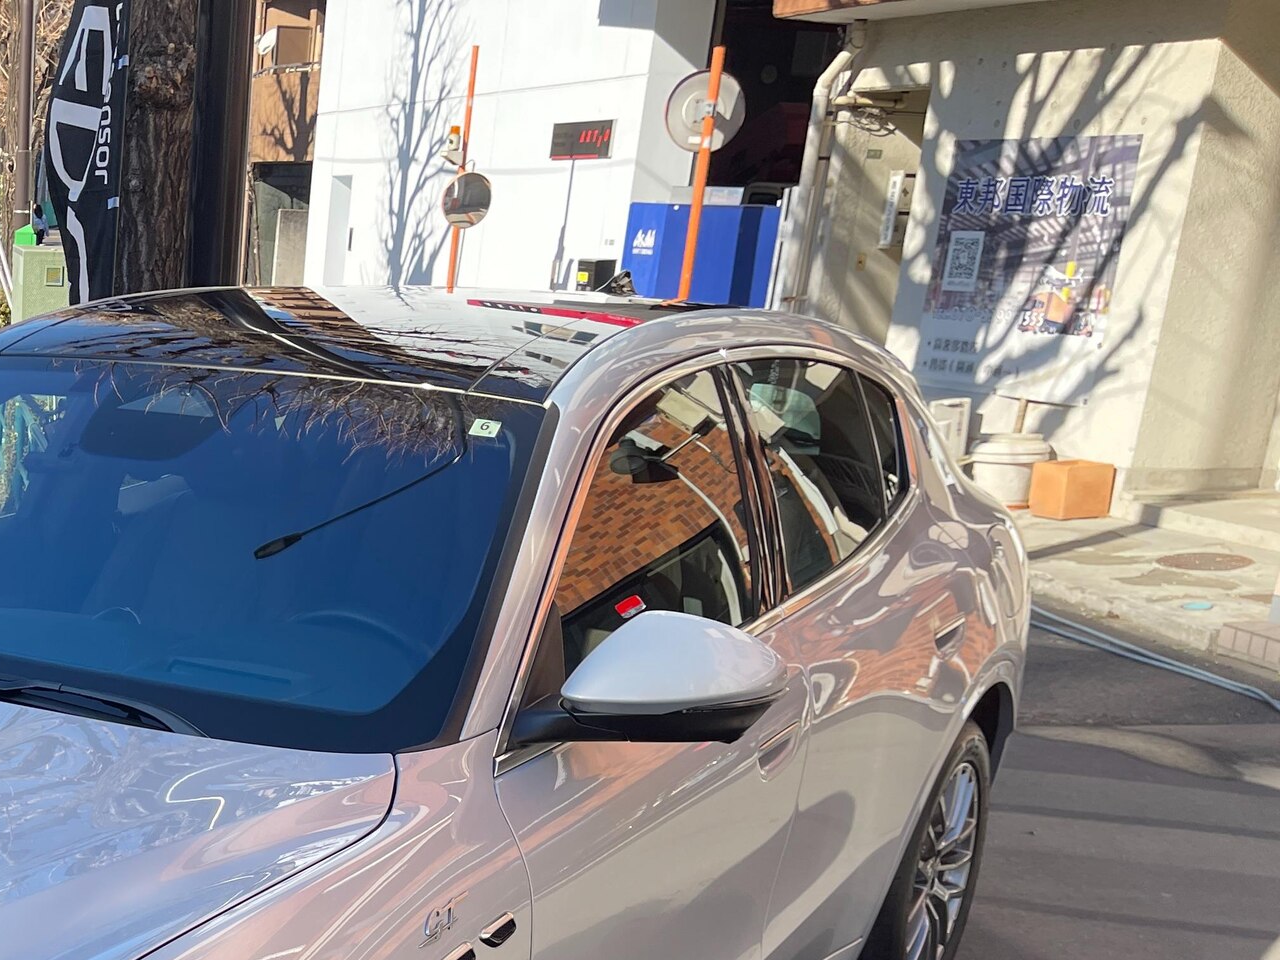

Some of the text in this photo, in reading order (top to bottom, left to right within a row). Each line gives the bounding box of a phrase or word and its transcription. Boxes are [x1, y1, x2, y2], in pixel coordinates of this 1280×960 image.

[952, 175, 1115, 217] 東邦国際物流
